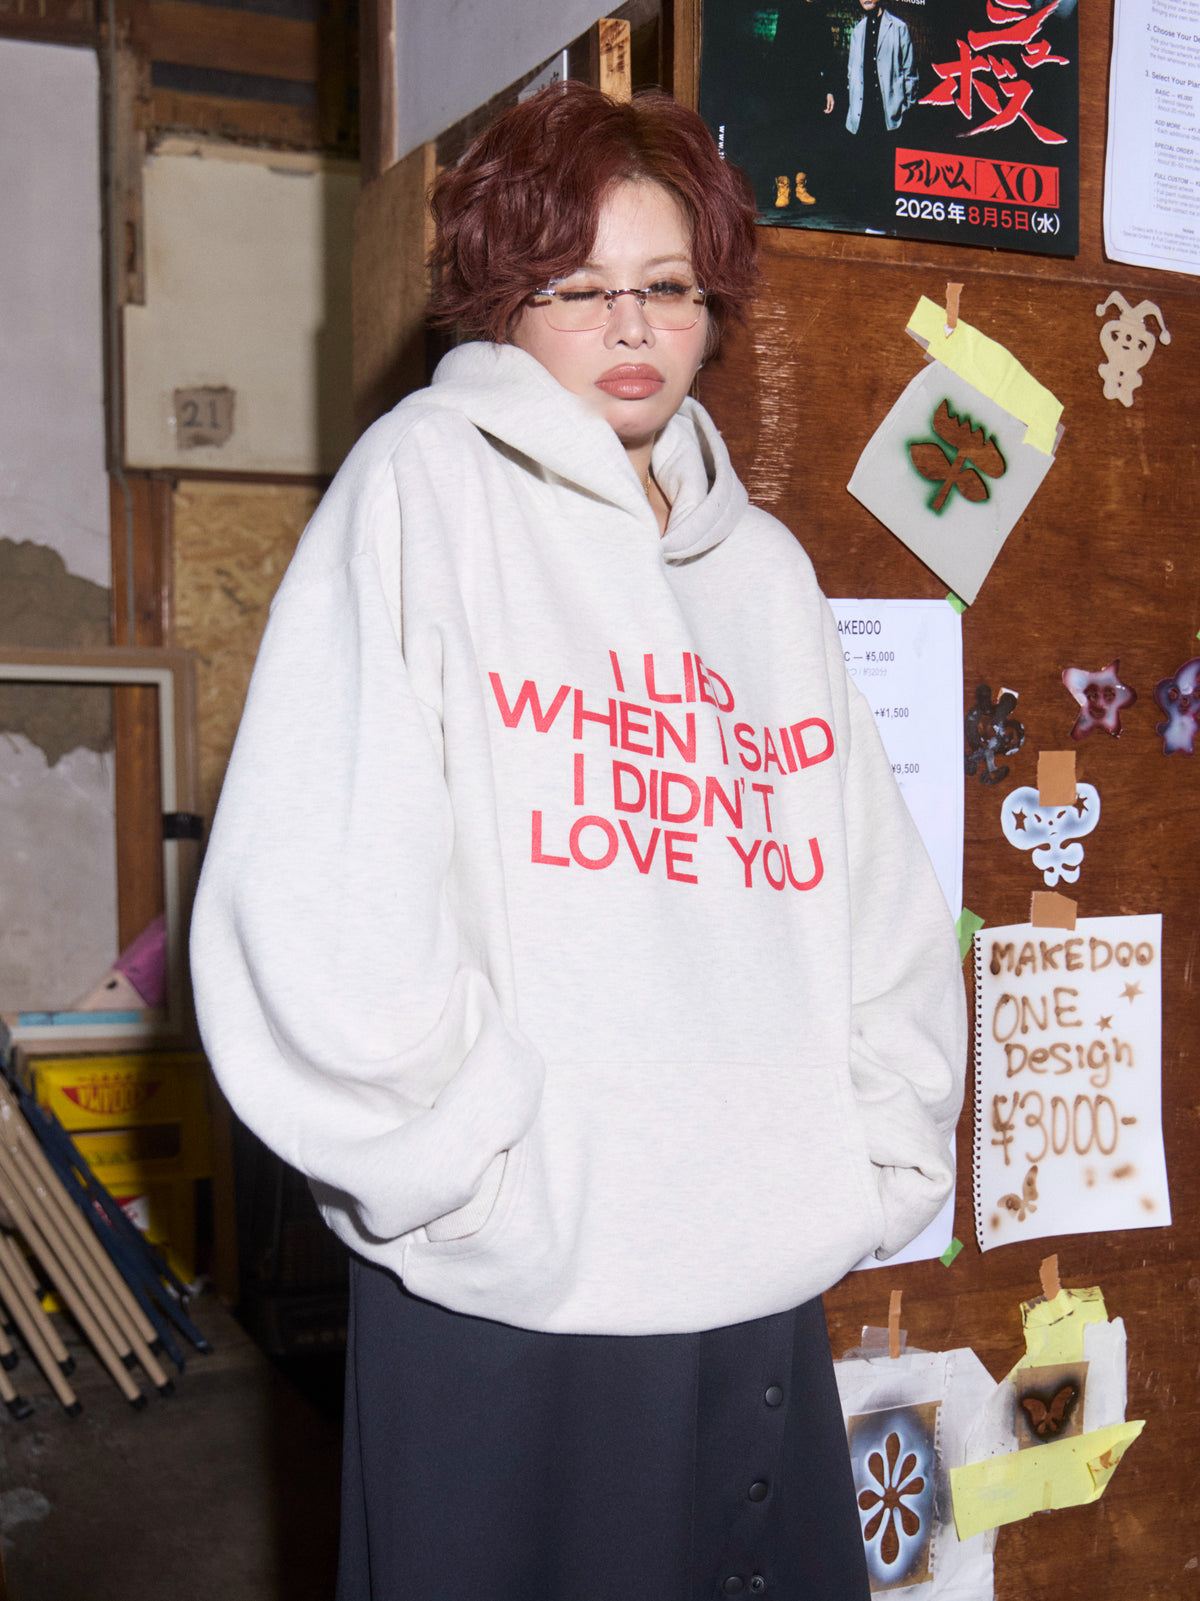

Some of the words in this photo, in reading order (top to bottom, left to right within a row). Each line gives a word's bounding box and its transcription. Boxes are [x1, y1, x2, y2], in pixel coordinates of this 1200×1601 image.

[1177, 31, 1191, 41] Your
[1171, 76, 1186, 86] Your
[181, 400, 221, 430] 21
[837, 620, 882, 635] AKEDOO
[866, 651, 895, 663] ¥5,000
[609, 650, 625, 693] I
[643, 652, 735, 713] LIED
[488, 671, 697, 763] WHEN
[717, 716, 729, 765] I
[733, 717, 835, 775] SAID
[574, 753, 584, 806] I
[612, 759, 774, 833] DIDN'T
[531, 810, 699, 885] LOVE
[726, 837, 825, 891] YOU
[989, 936, 1155, 977] MAKEDOO
[992, 986, 1083, 1043] ONE
